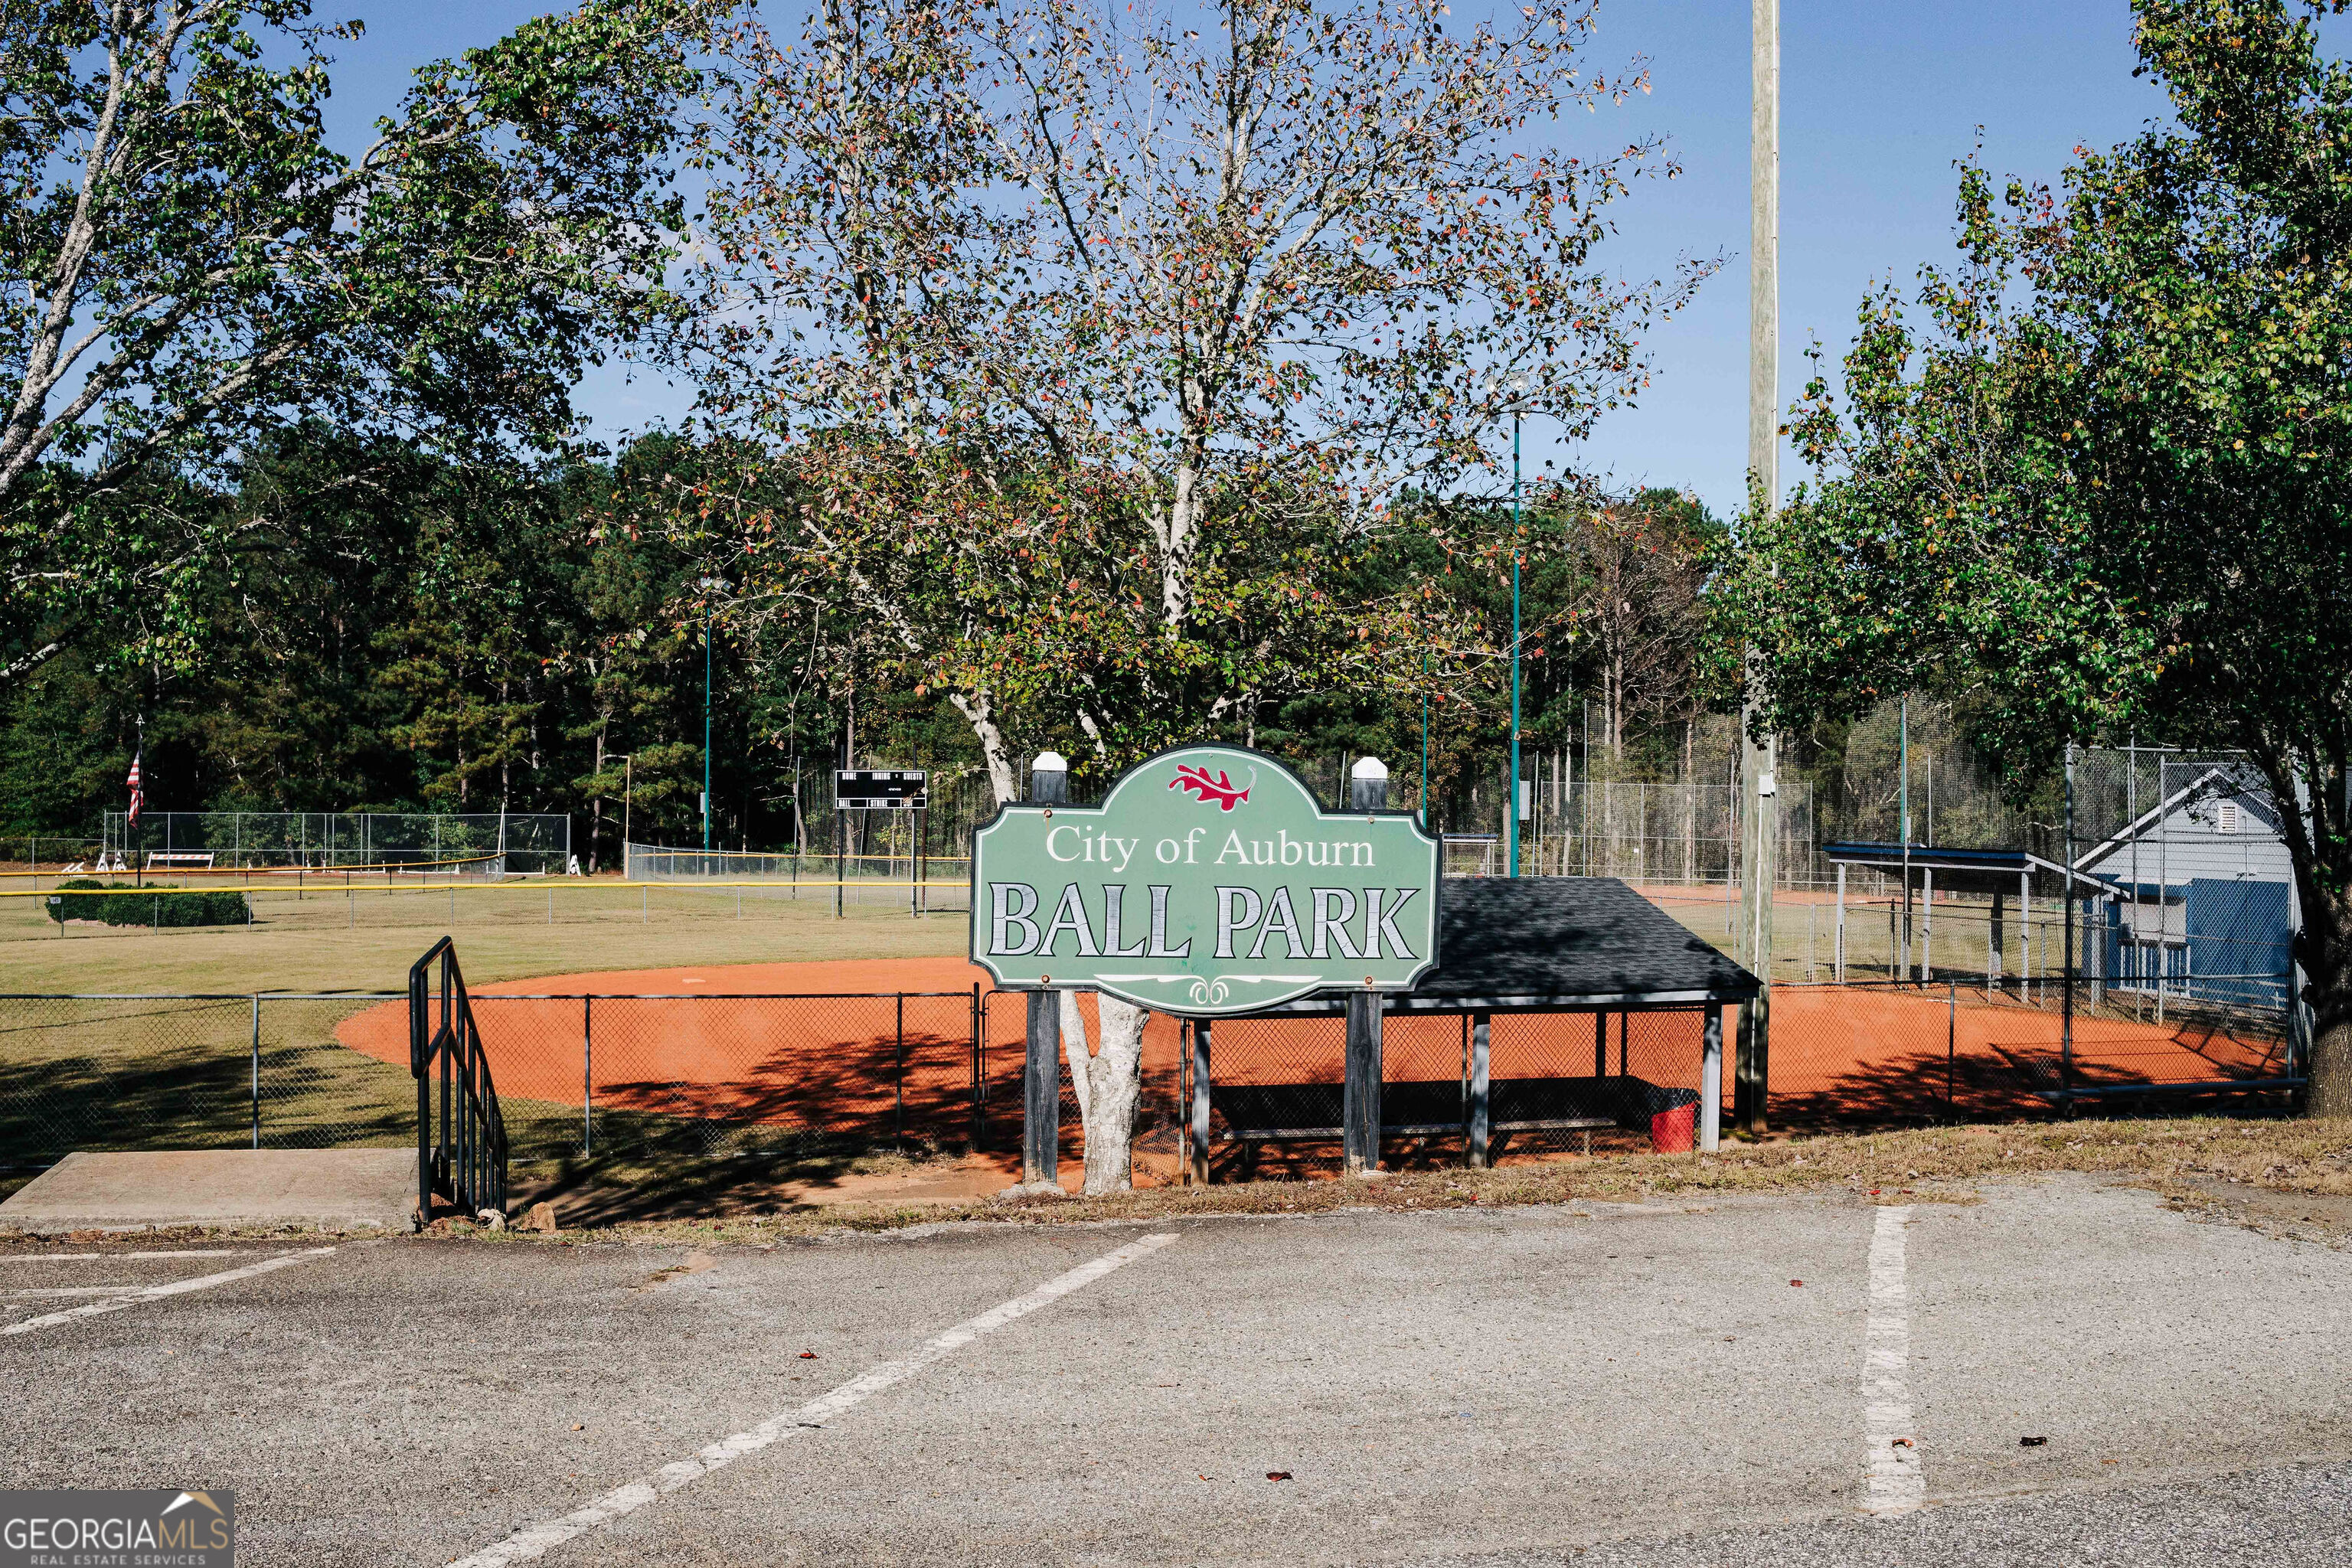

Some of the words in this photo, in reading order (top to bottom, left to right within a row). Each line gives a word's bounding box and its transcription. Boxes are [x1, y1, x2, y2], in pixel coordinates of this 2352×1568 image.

[842, 772, 857, 780] HOME
[872, 772, 890, 780] INNING
[903, 772, 923, 780] GUESTS
[1045, 825, 1139, 873] City
[1155, 827, 1207, 864] of
[1214, 828, 1376, 867] Auburn
[987, 881, 1192, 958] BALL
[1212, 885, 1421, 960] PARK
